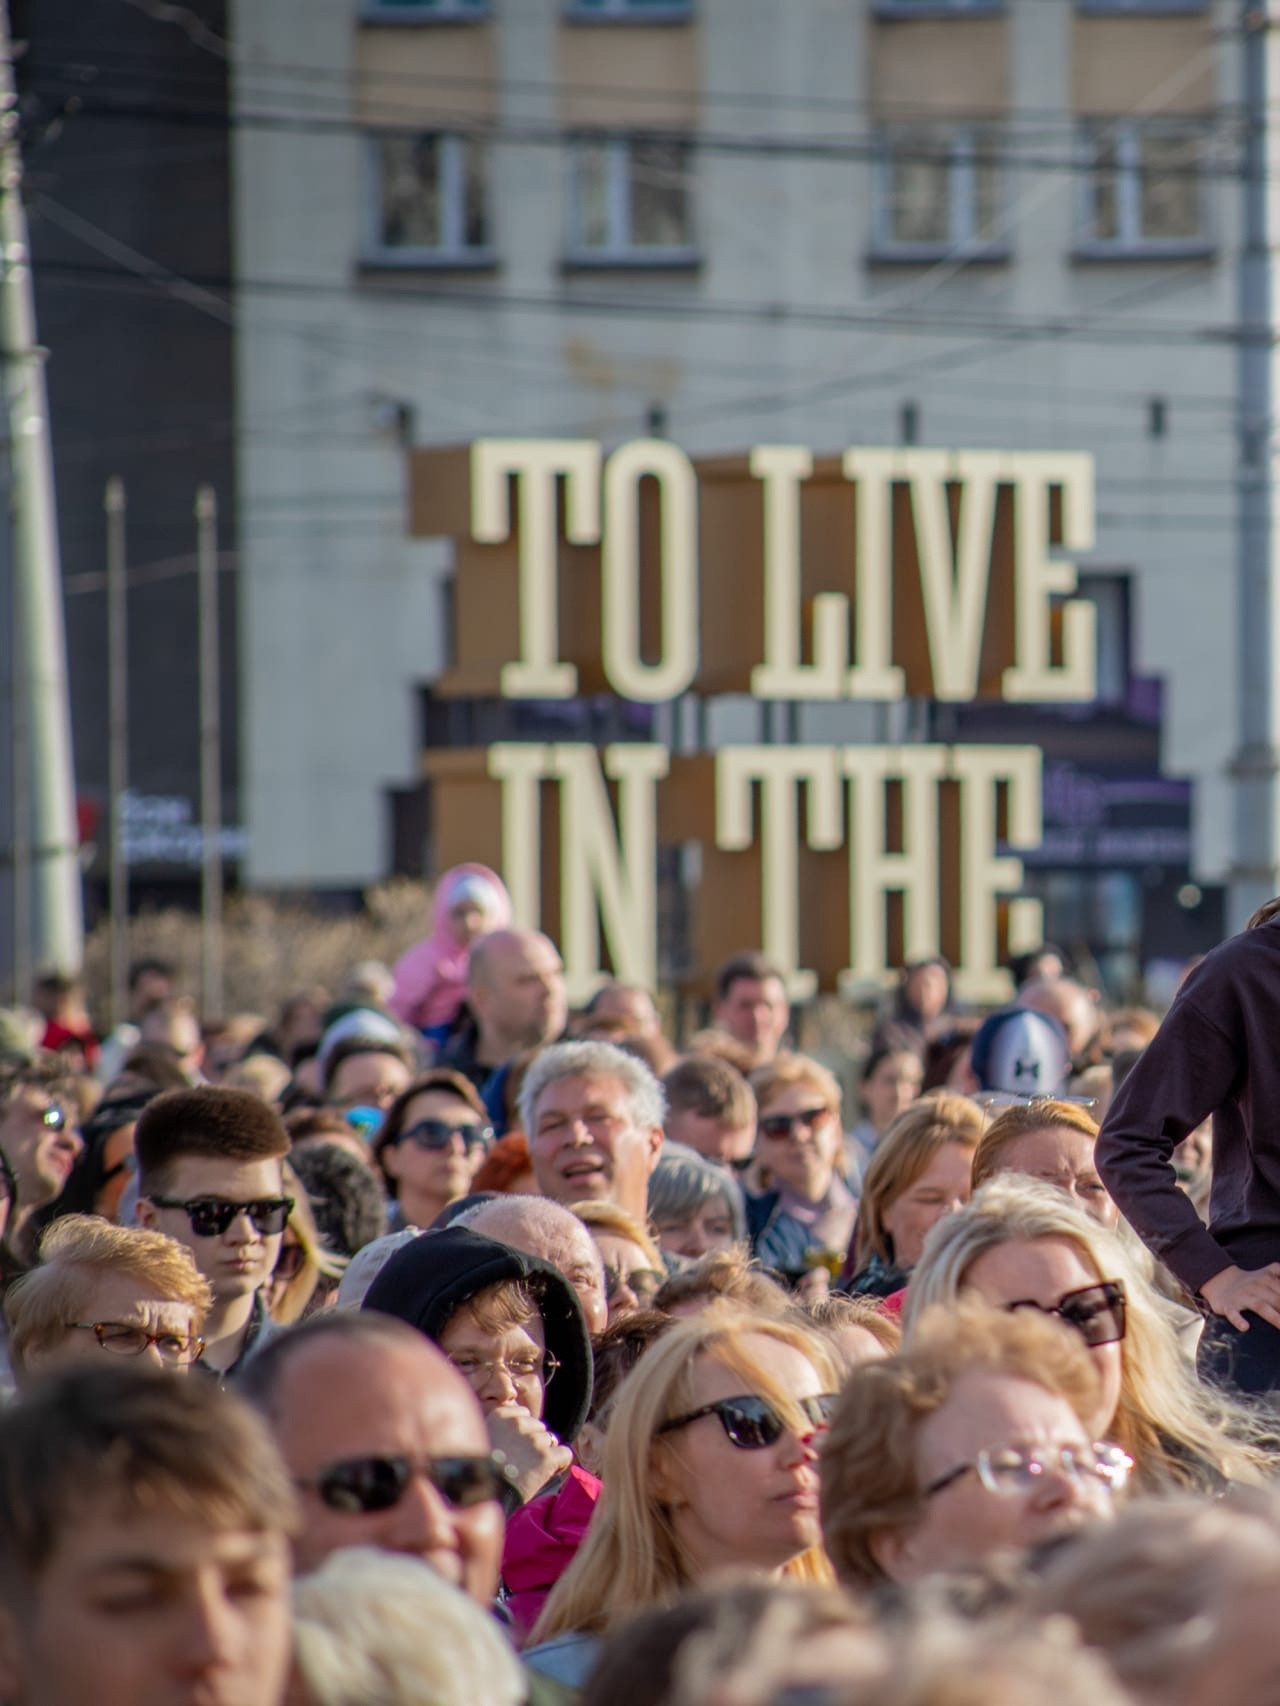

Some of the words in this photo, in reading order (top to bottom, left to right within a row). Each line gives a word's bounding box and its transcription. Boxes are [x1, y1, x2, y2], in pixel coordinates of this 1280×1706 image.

[471, 438, 698, 702] TO
[750, 444, 1096, 703] LIVE
[487, 741, 670, 1006] IN
[715, 744, 1044, 1003] THE
